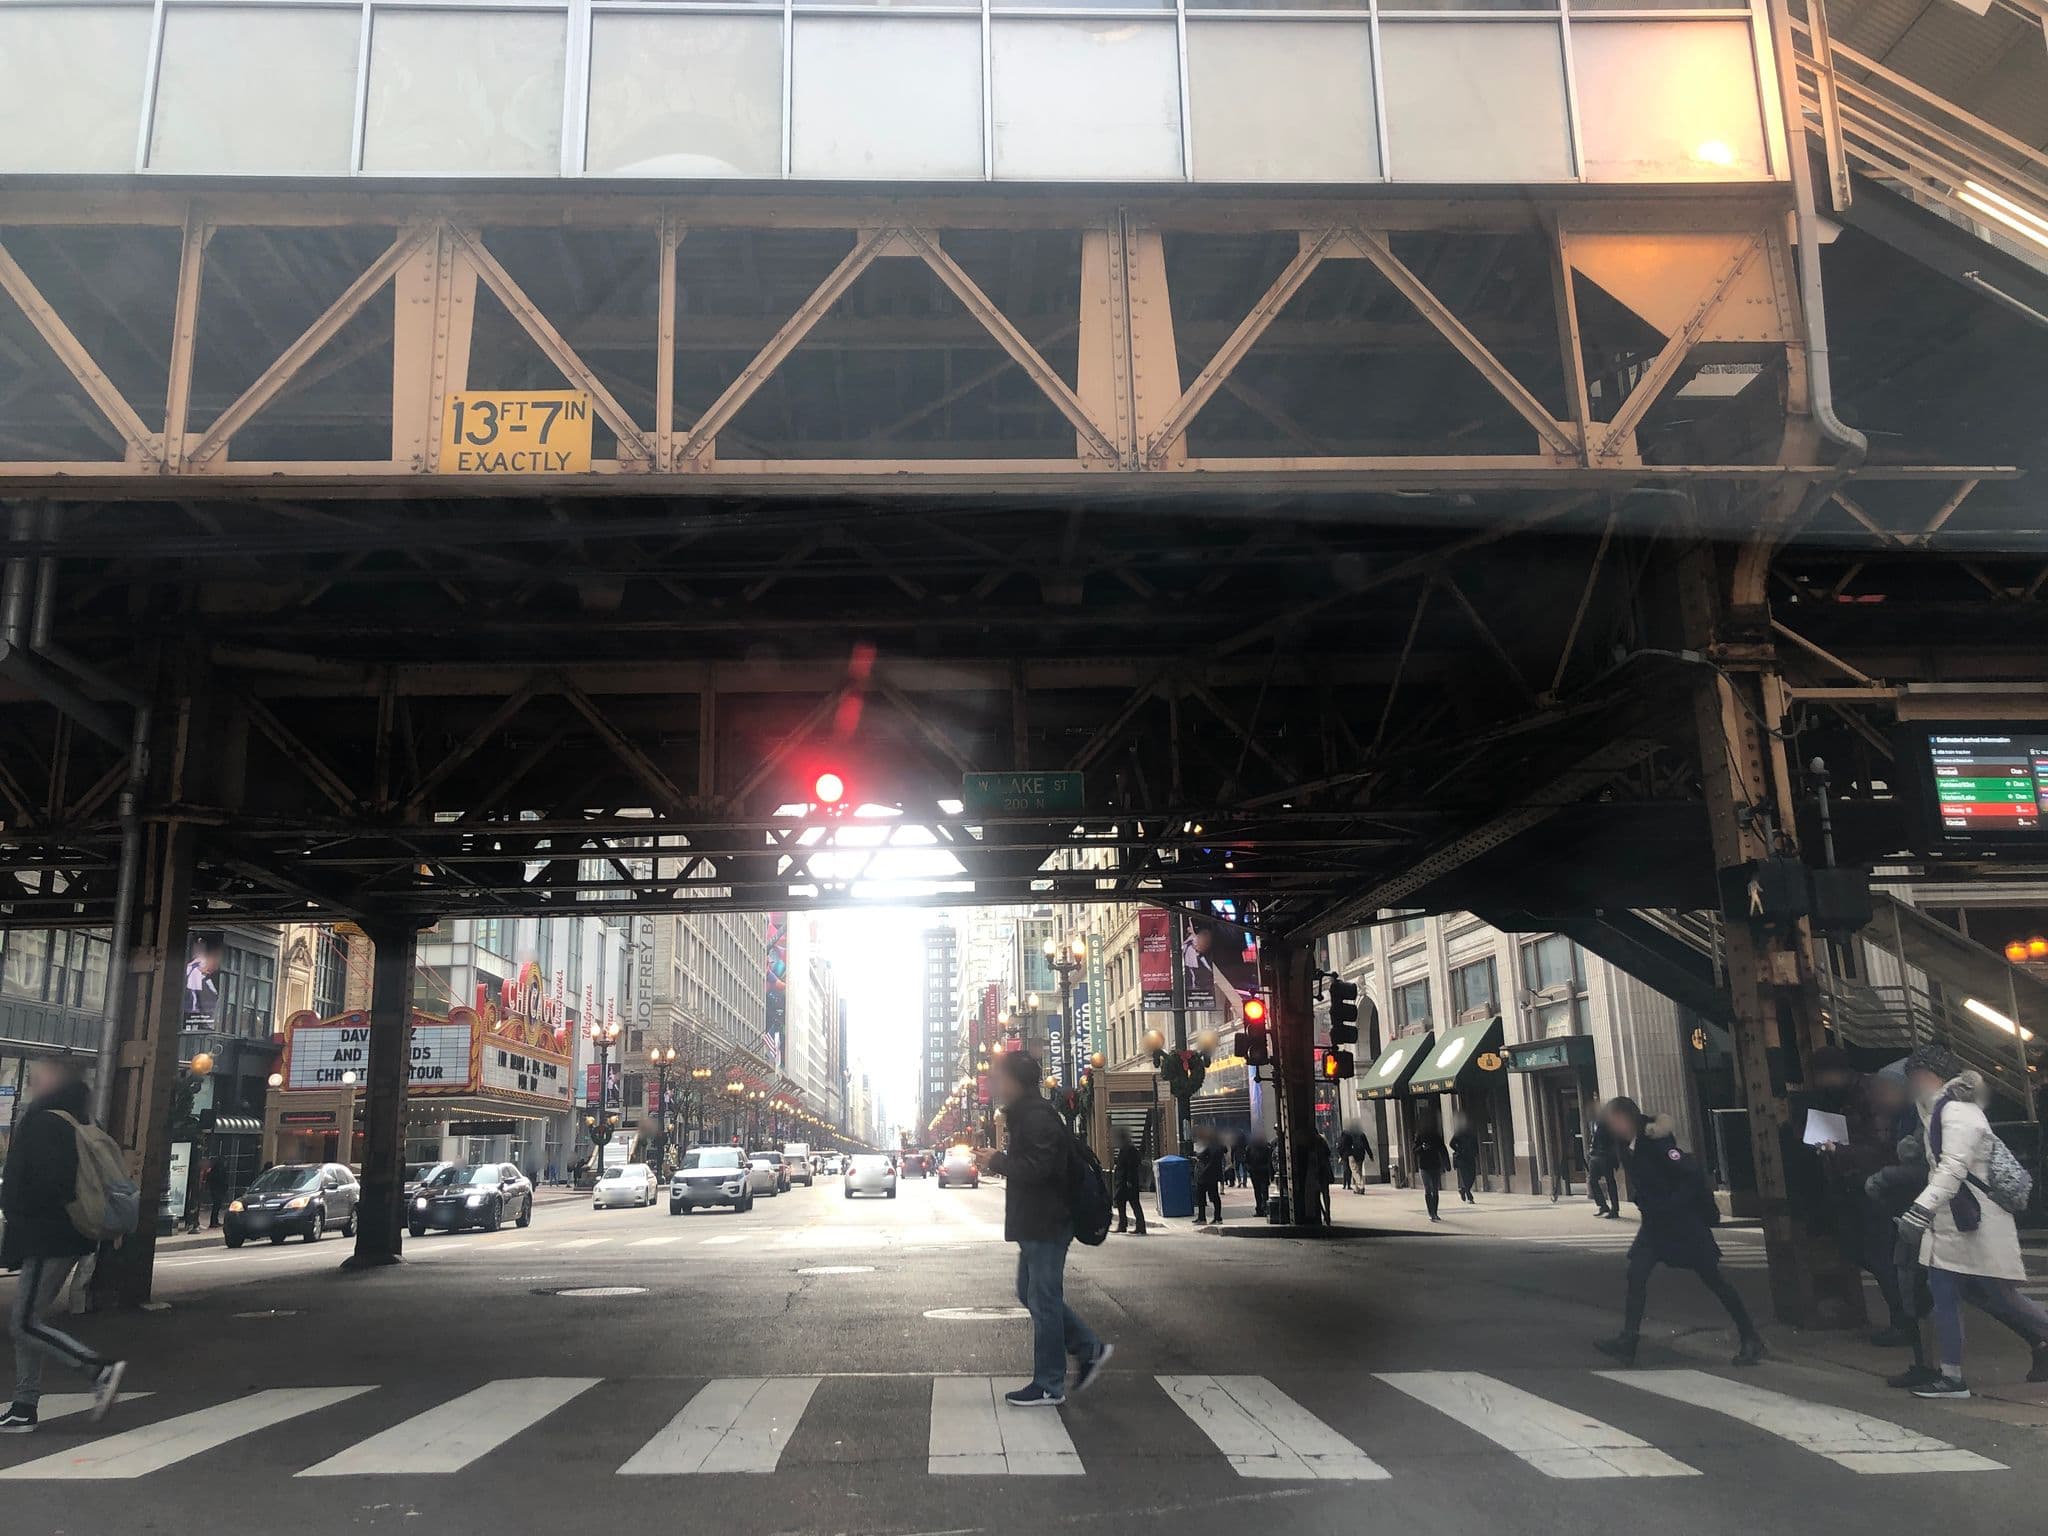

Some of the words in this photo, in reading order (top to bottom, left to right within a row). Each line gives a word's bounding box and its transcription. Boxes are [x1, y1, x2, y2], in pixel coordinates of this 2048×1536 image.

[457, 451, 572, 473] EXACTLY
[1054, 779, 1069, 791] ST
[1091, 939, 1100, 975] GENE
[638, 941, 654, 1030] JOFFREY
[581, 984, 595, 1040] Walgreens
[1094, 979, 1103, 1033] SISKEL
[333, 1048, 362, 1062] AND
[1050, 1030, 1061, 1054] OLD
